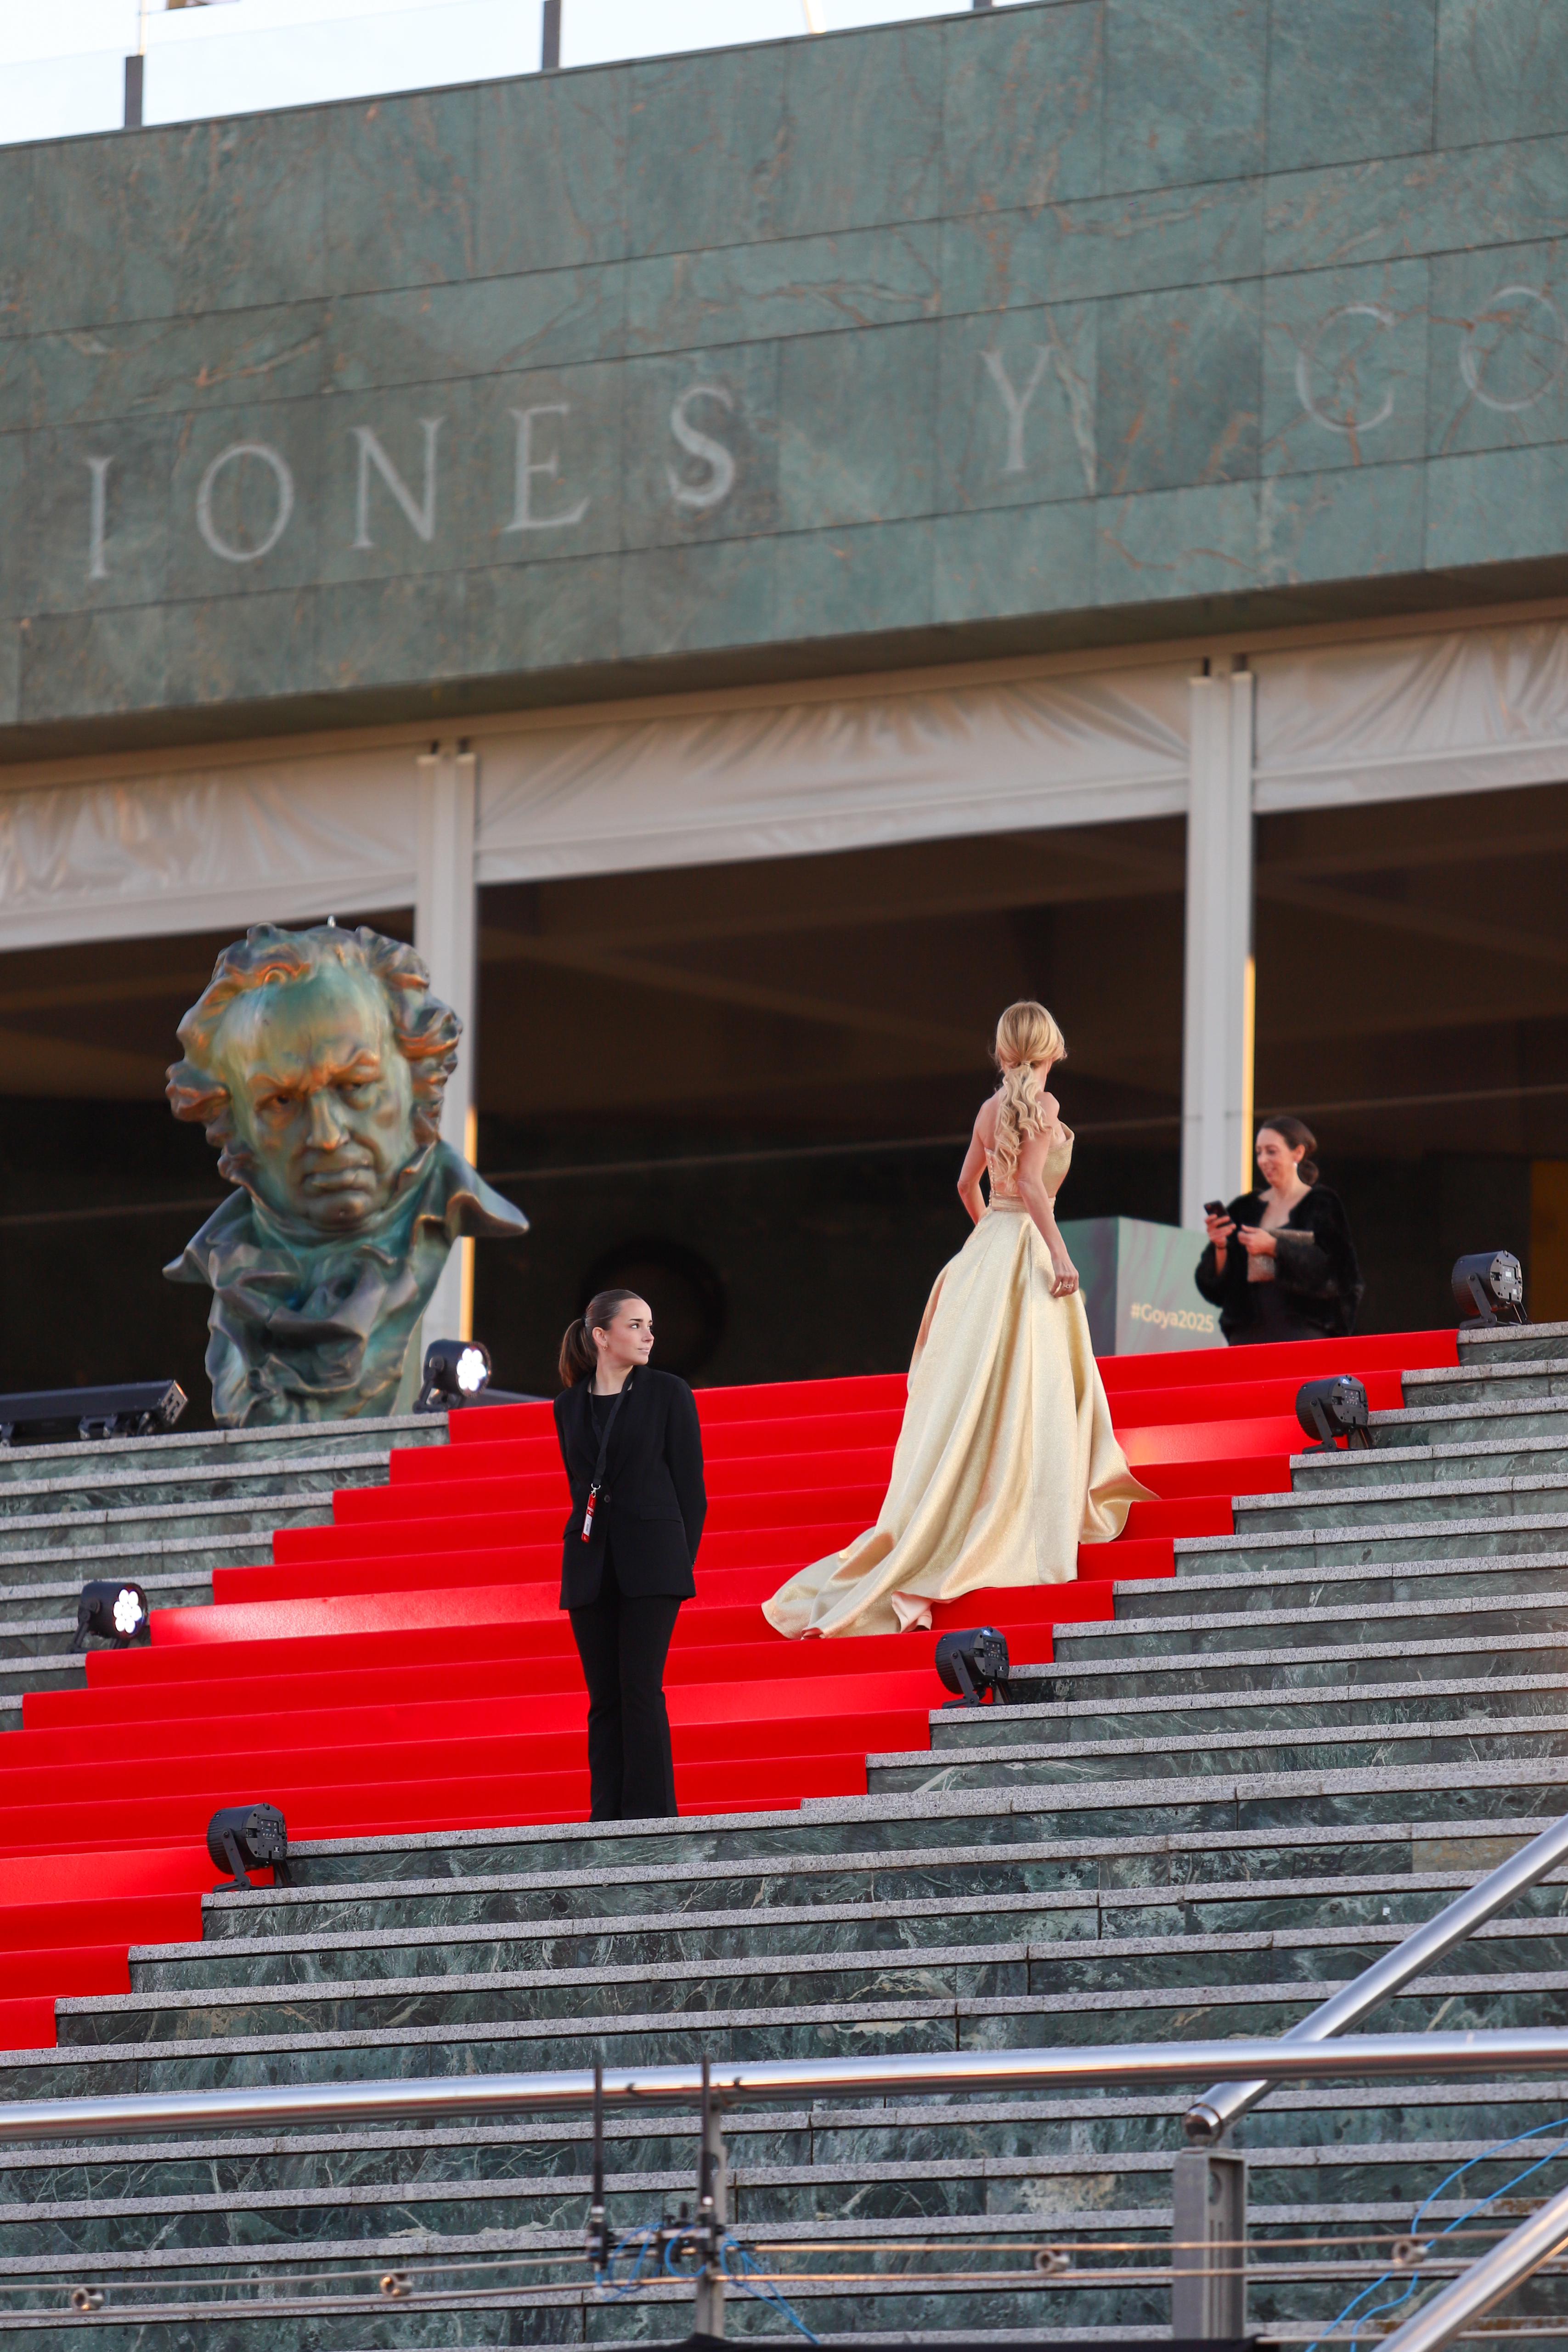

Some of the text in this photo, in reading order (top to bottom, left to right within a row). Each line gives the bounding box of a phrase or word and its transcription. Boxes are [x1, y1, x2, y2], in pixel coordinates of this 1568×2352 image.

[85, 385, 735, 580] IONES
[977, 345, 1054, 472] Y
[1130, 1302, 1215, 1333] #Goya2025
